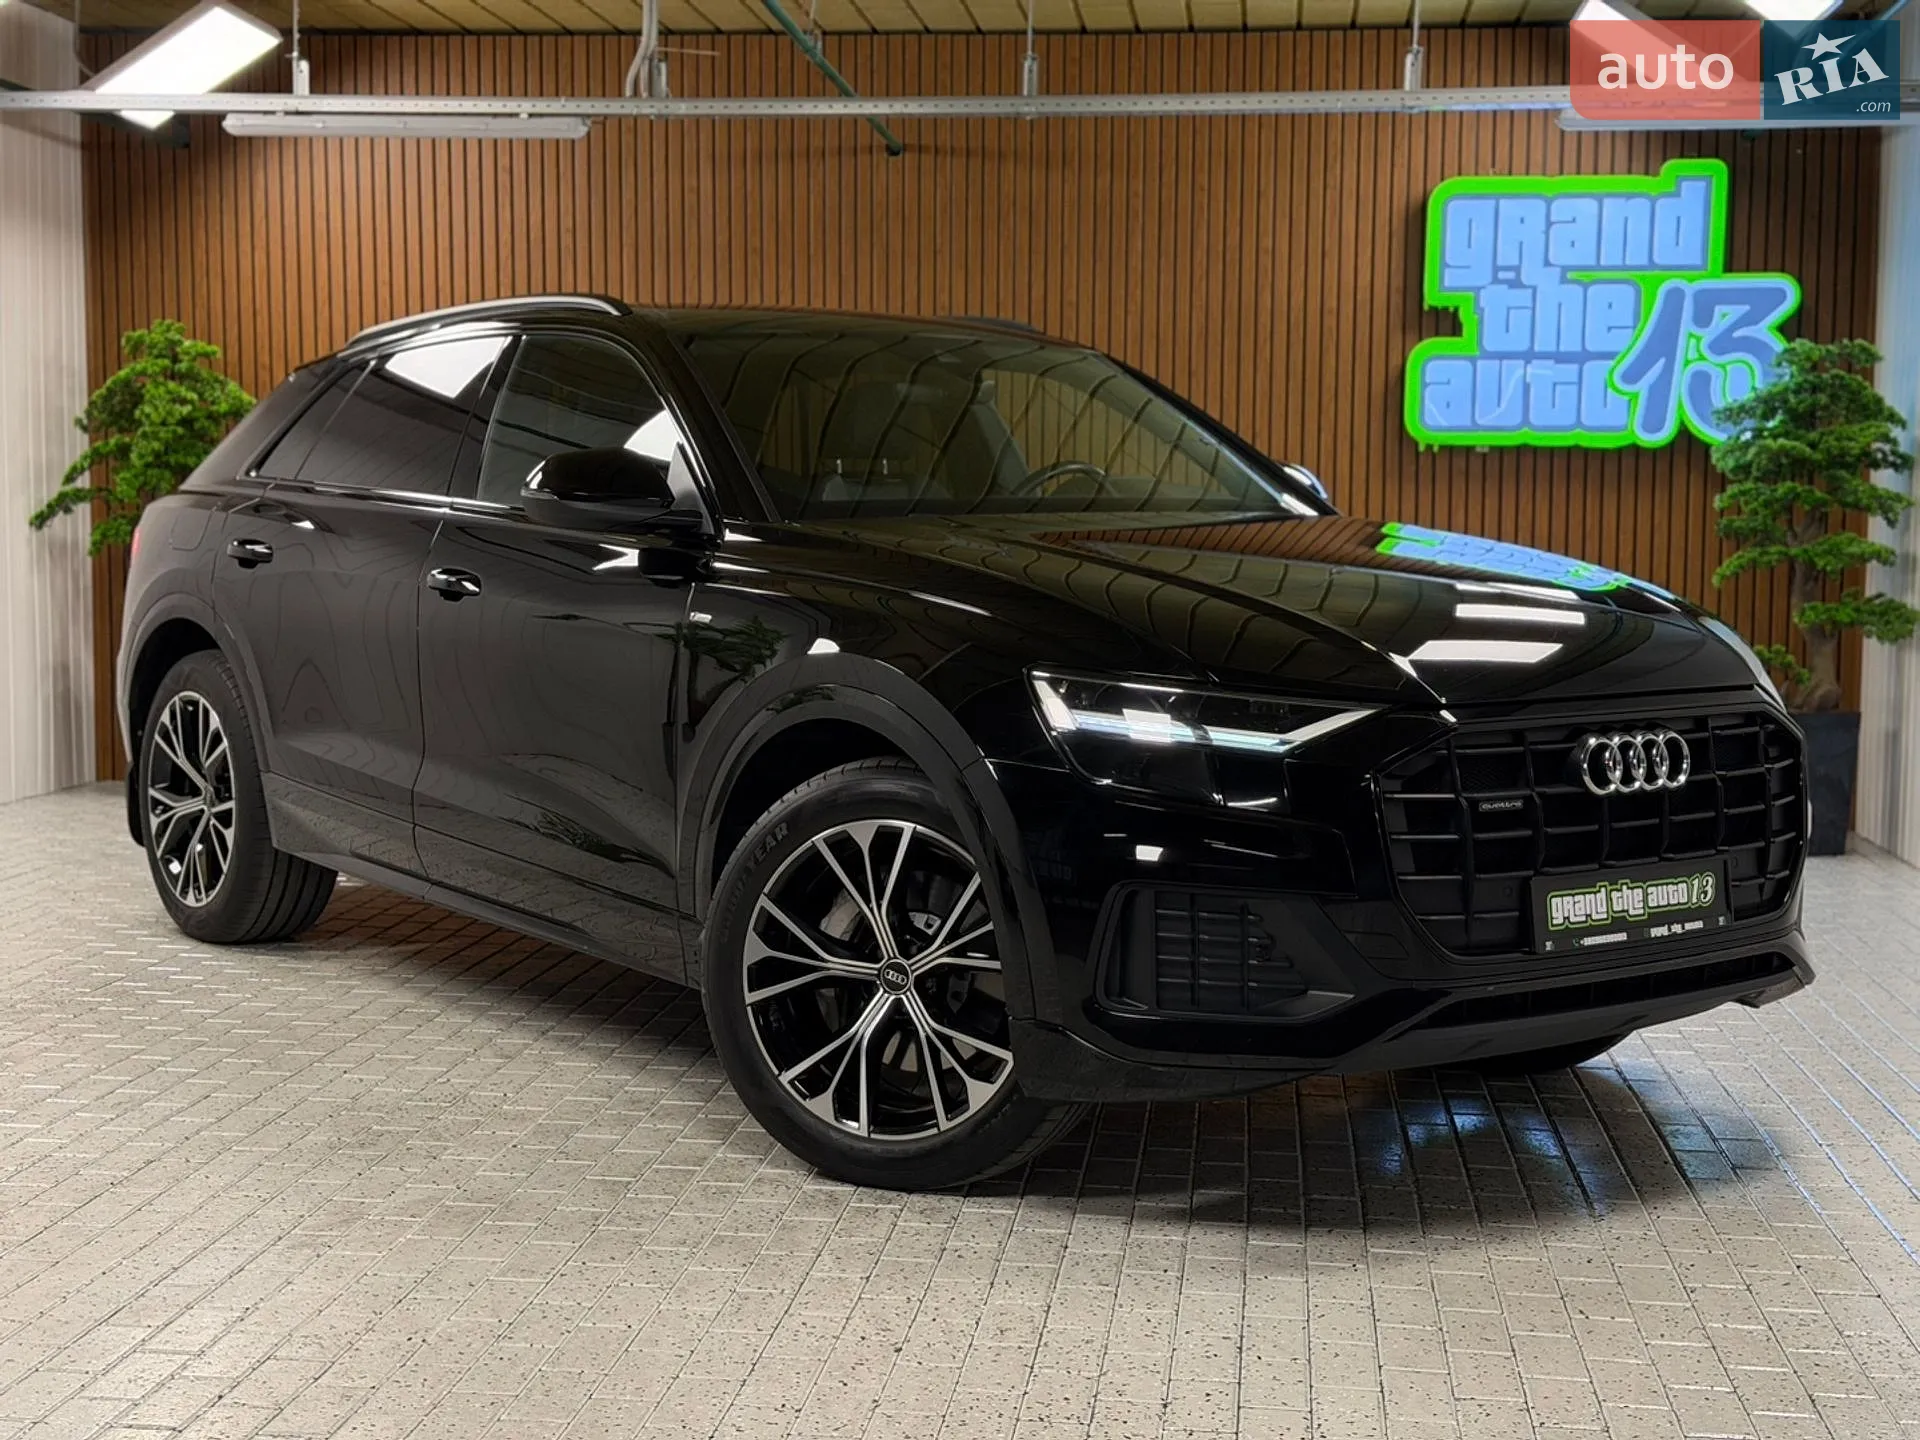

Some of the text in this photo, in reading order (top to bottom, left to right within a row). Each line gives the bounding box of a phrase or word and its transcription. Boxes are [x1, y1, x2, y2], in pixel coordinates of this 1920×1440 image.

[1480, 267, 1639, 353] the
[1612, 279, 1796, 440] 13
[720, 822, 789, 943] YEAR
[1611, 883, 1644, 916] the
[1646, 881, 1688, 908] auto
[1691, 874, 1714, 905] 13
